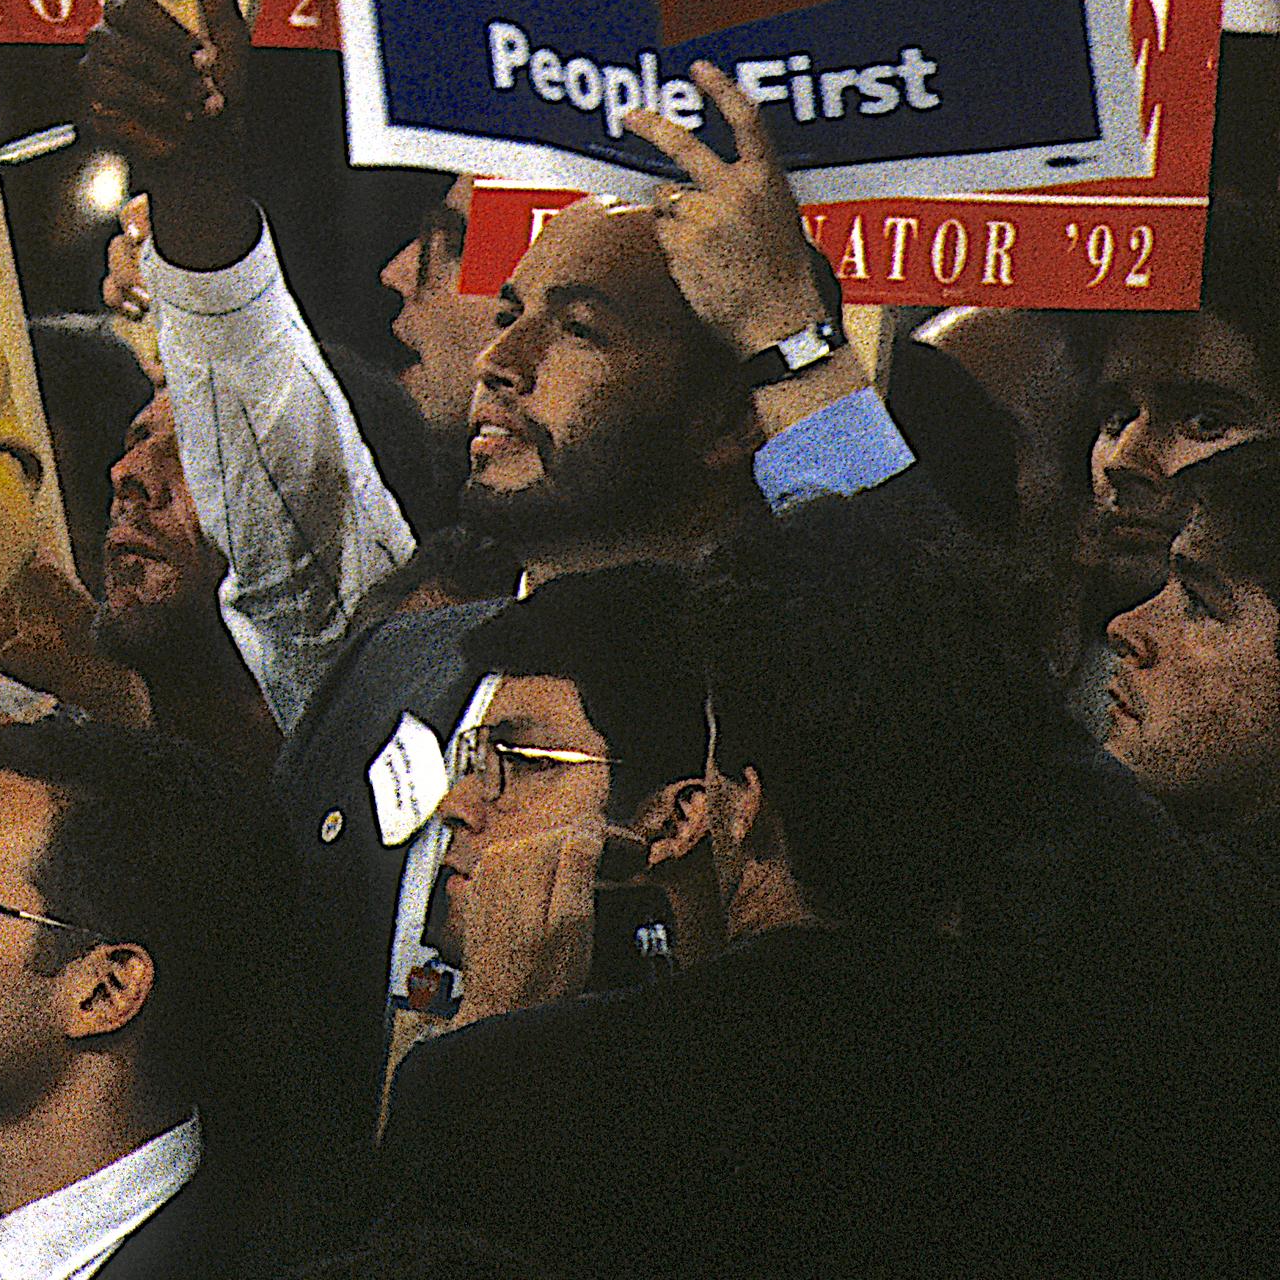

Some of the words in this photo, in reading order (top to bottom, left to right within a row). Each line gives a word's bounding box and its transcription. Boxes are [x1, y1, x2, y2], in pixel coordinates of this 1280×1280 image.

[486, 18, 707, 139] People
[736, 46, 943, 125] First
[1064, 221, 1156, 290] '92
